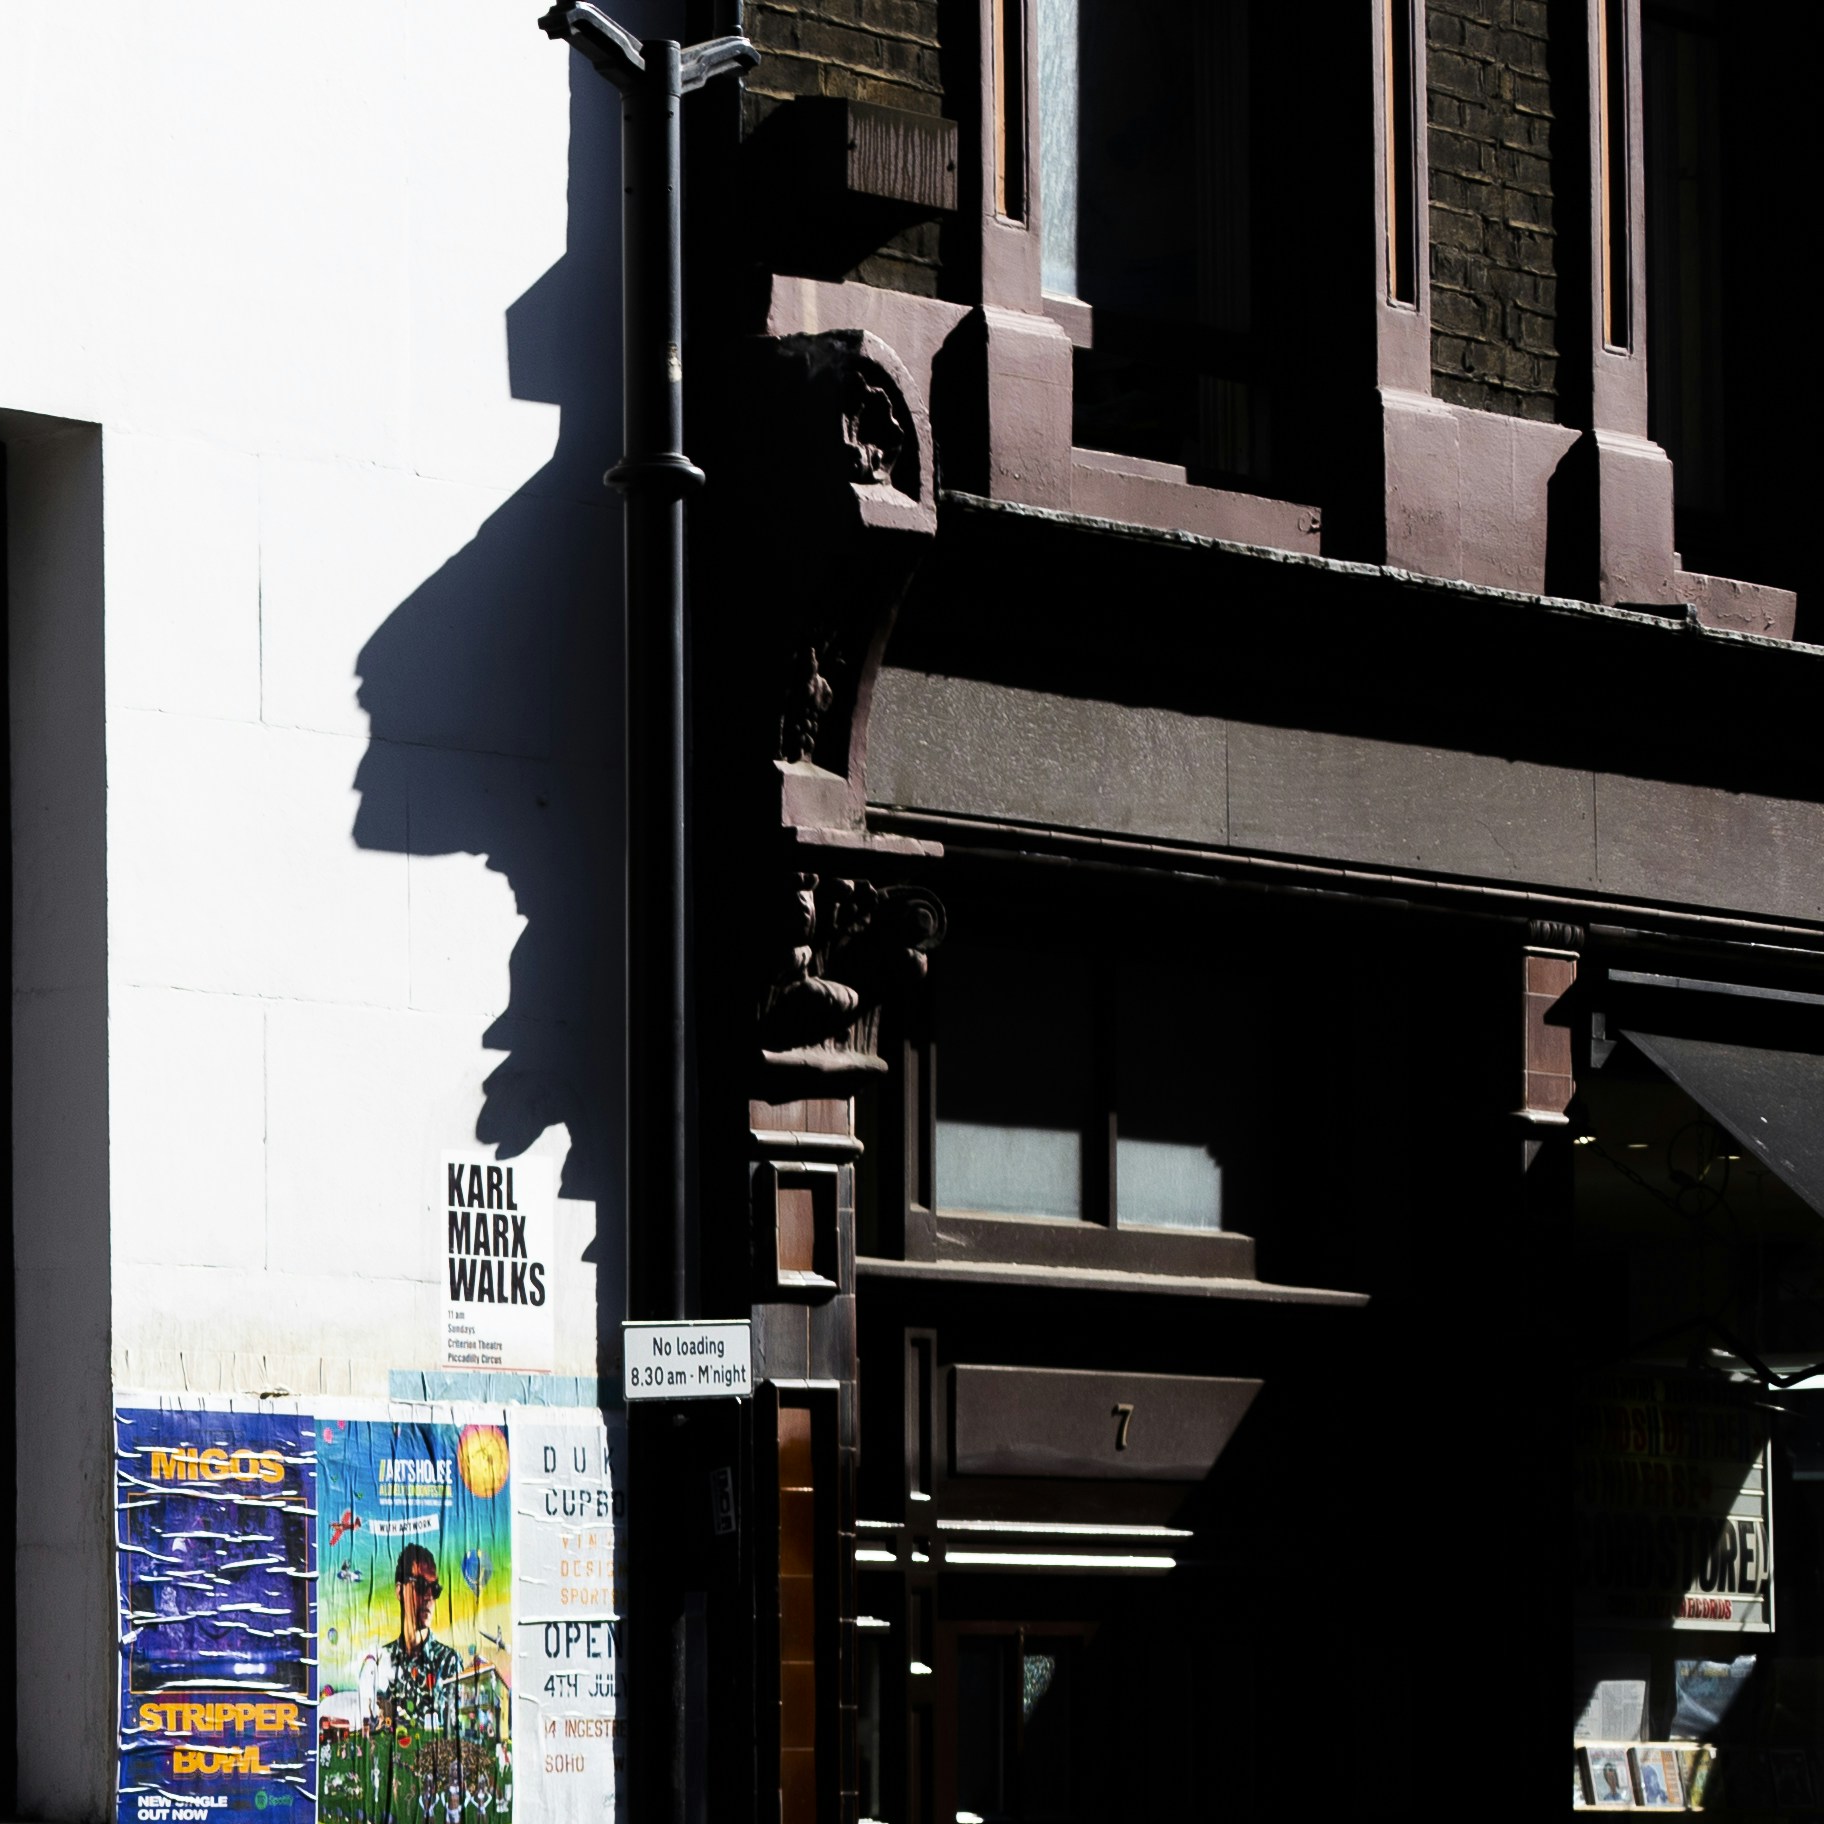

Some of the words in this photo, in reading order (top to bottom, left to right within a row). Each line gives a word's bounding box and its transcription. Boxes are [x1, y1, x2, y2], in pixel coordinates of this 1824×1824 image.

[447, 1163, 518, 1211] KARL
[448, 1210, 528, 1259] MARX
[448, 1257, 546, 1307] WALKS
[652, 1337, 672, 1357] No
[676, 1336, 725, 1358] loading
[631, 1368, 665, 1387] 8.30
[667, 1371, 687, 1386] am
[697, 1364, 747, 1387] M'night
[1111, 1401, 1135, 1453] 7
[150, 1448, 286, 1484] MIGOS
[545, 1621, 624, 1659] OPEN
[138, 1702, 300, 1734] STRIPPER
[172, 1746, 272, 1775] BOWL
[545, 1754, 585, 1774] SOHO
[137, 1795, 172, 1809] NEW
[137, 1808, 170, 1822] OUT
[171, 1808, 209, 1822] NOW
